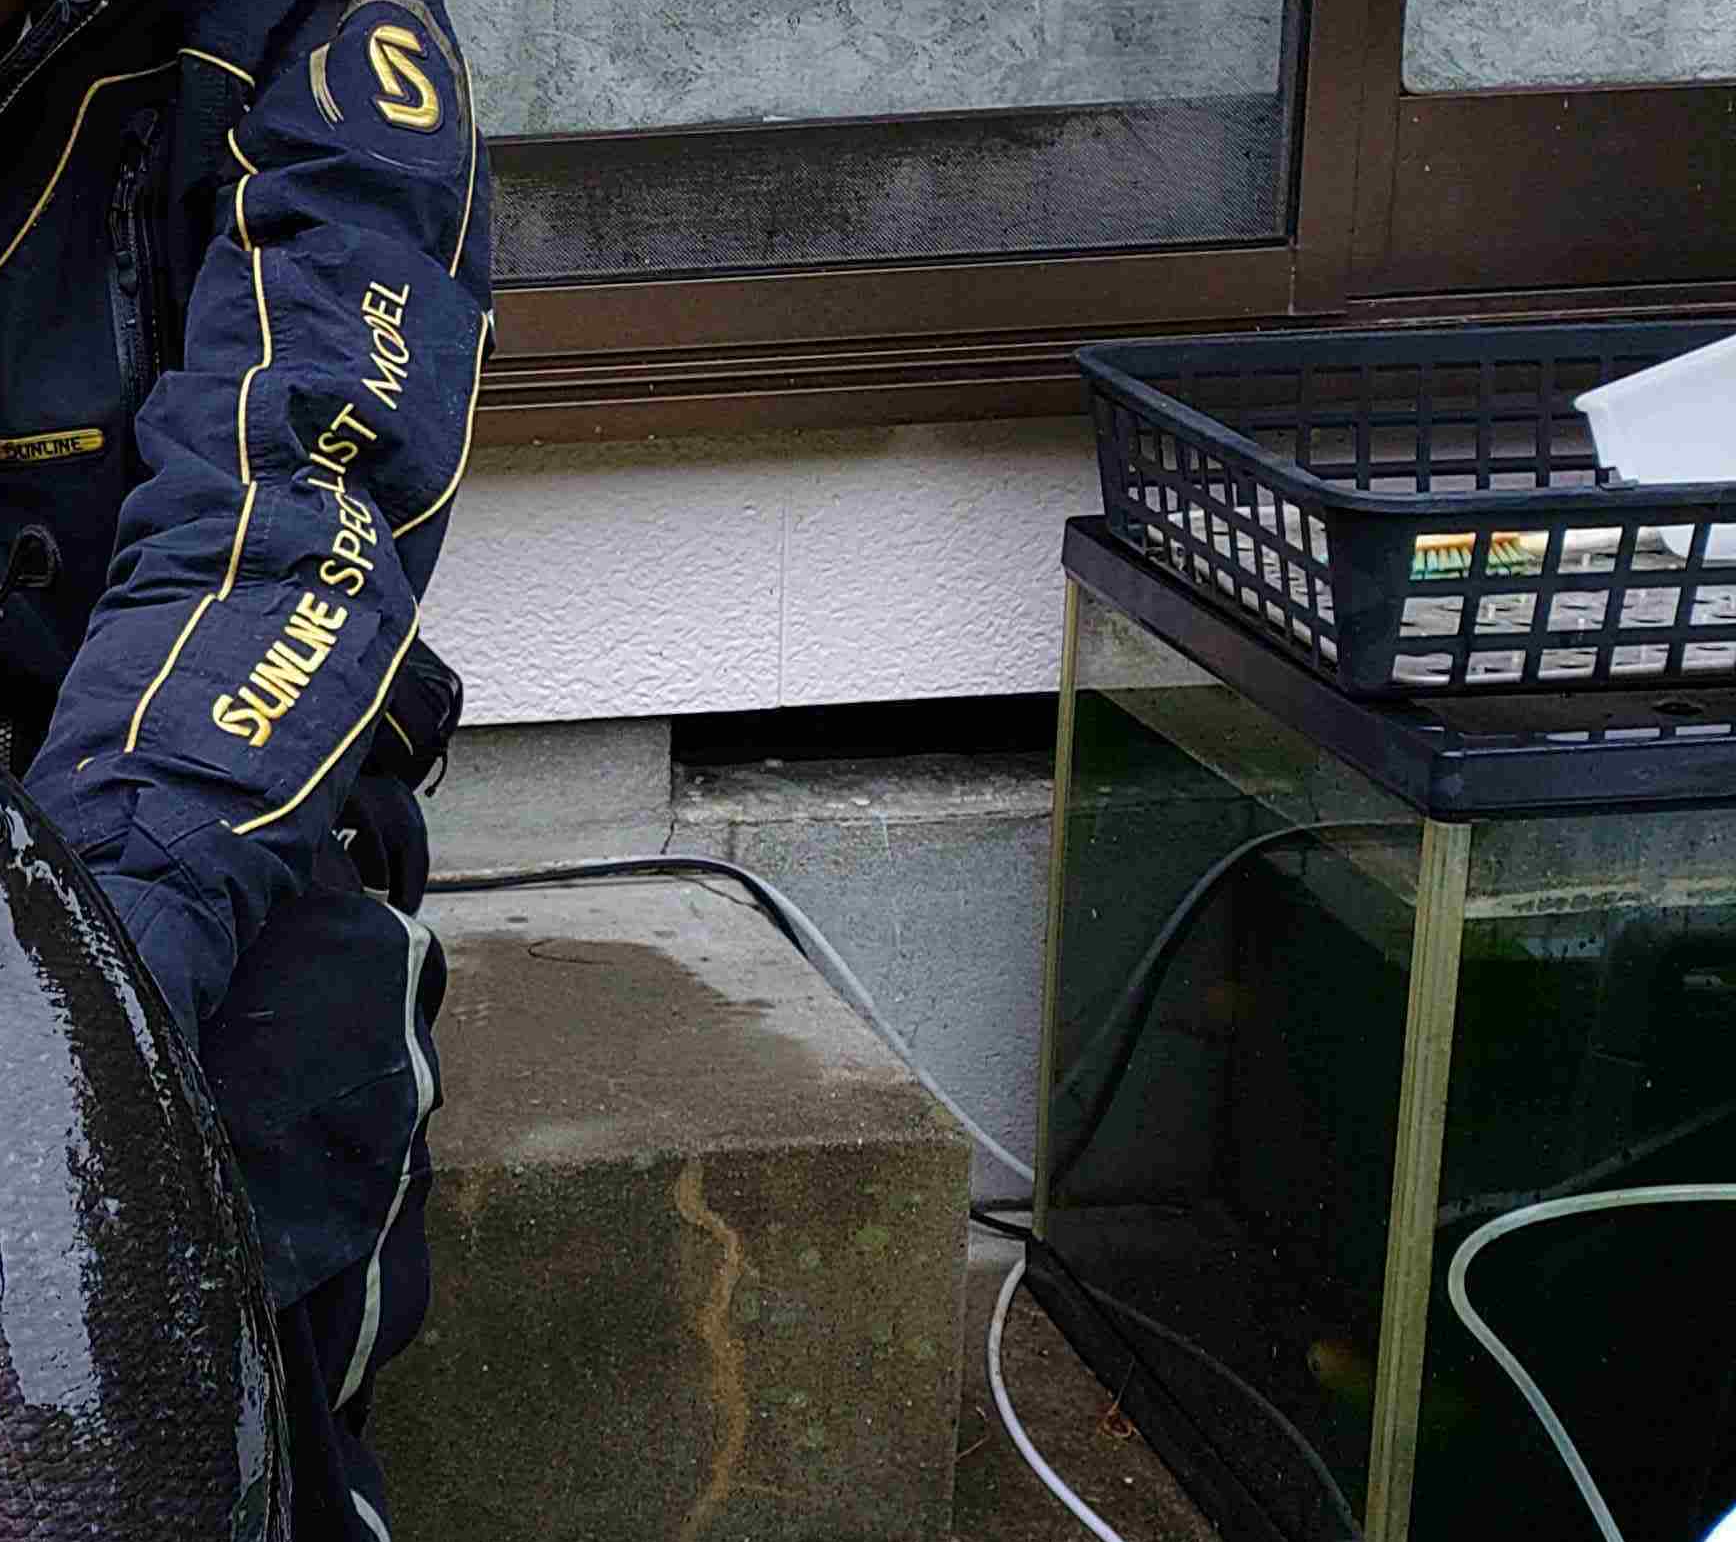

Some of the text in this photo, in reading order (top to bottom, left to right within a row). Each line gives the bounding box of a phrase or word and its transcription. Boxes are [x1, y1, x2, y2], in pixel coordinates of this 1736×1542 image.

[7, 436, 82, 460] SUNLINE
[212, 591, 348, 748] SUNLNE
[308, 402, 377, 597] SPECLIST
